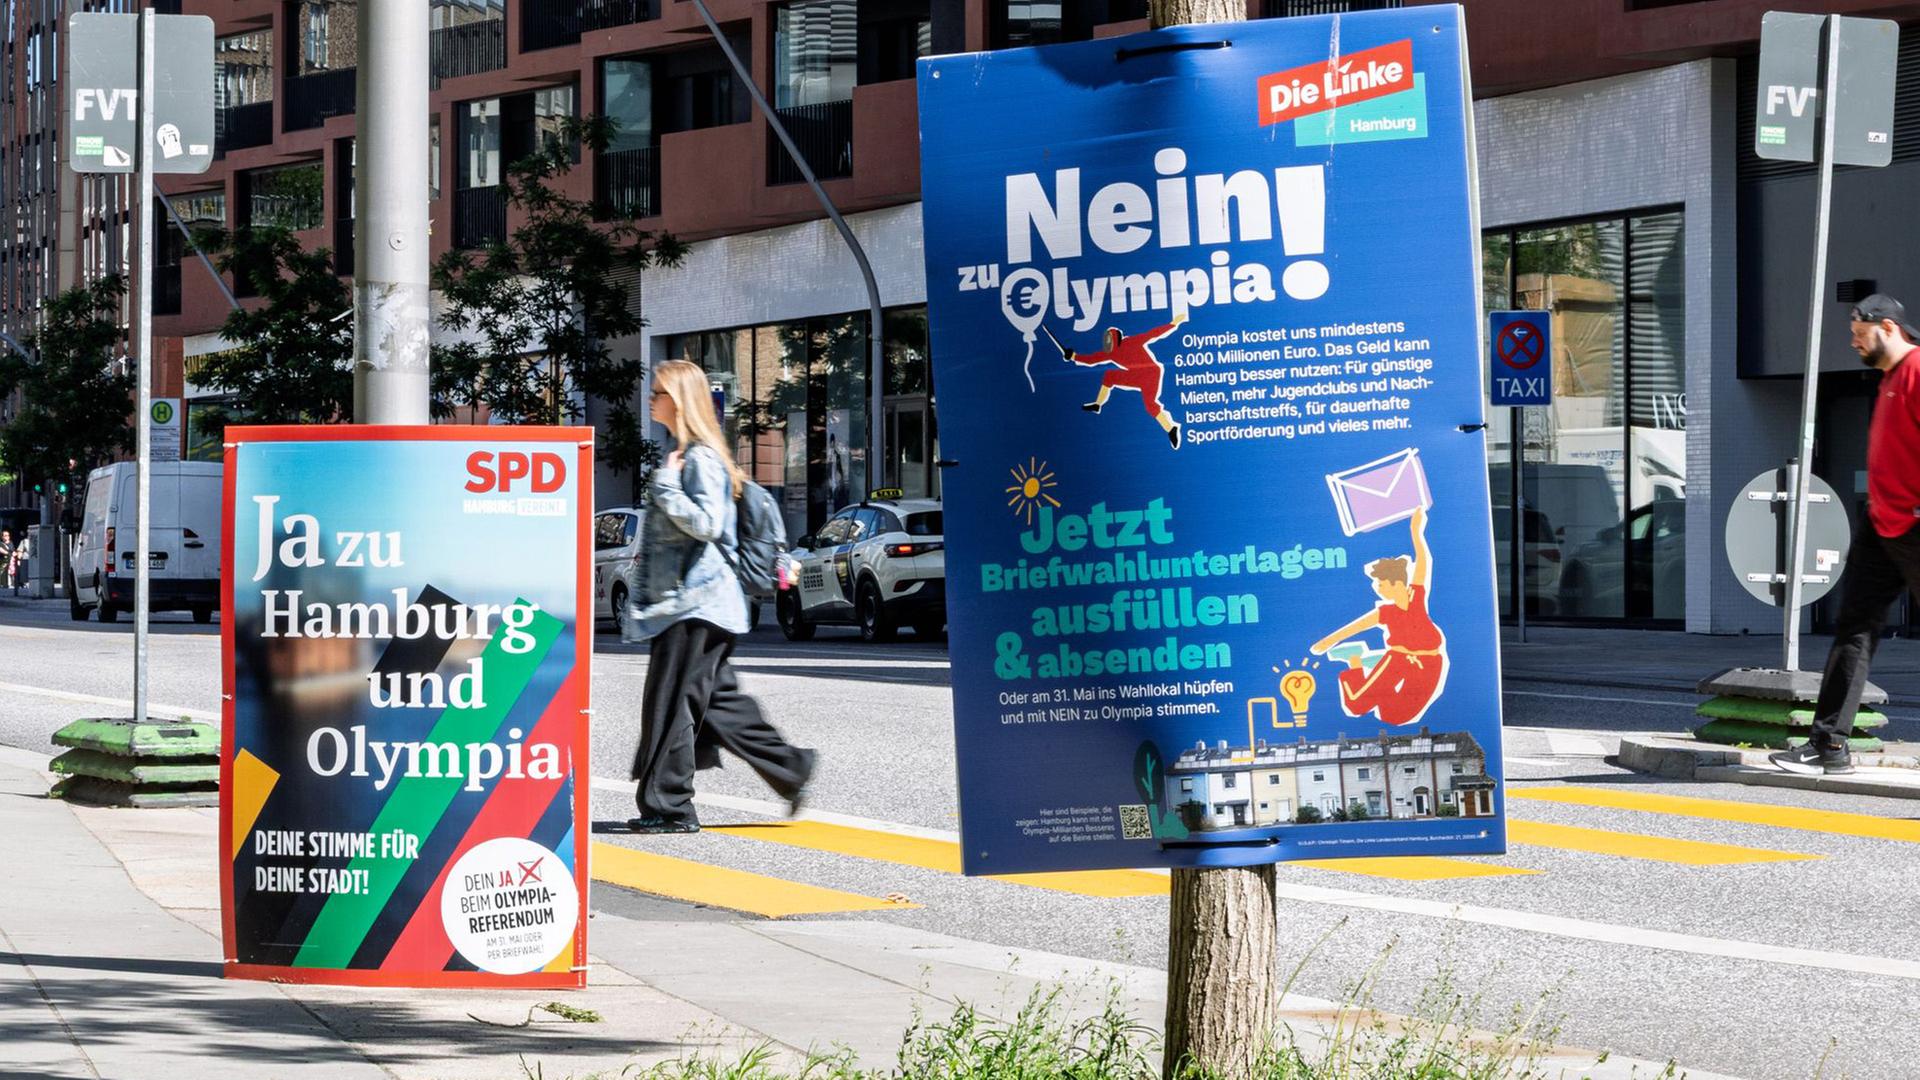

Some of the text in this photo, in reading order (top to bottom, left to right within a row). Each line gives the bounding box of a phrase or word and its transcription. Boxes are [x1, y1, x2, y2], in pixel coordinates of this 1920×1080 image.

[1270, 60, 1404, 113] Die Linke
[1350, 117, 1416, 132] Hamburg
[1006, 148, 1330, 300] Nein!
[958, 264, 1000, 291] zu
[1182, 322, 1405, 350] Olympia kostet uns mindestens
[1174, 338, 1430, 368] 6.000 Millionen Euro. Das Geld kann
[1175, 356, 1433, 386] Hamburg besser nutzen: Für günstige
[1180, 376, 1434, 406] Mieten, mehr Jugendclubs und Nach-
[1496, 378, 1545, 398] TAXI
[156, 406, 167, 418] H
[1186, 397, 1410, 424] barschaftstreffs, für dauerhafte
[1186, 416, 1412, 444] Sportförderung und vieles mehr.
[464, 450, 566, 494] SPD
[463, 500, 516, 514] HAMBURG
[252, 495, 404, 582] Ja zu
[1020, 497, 1174, 554] Jetzt
[981, 544, 1348, 592] Briefwahlunterlagen
[260, 588, 540, 654] Hamburg
[1032, 588, 1259, 637] ausfüllen
[994, 632, 1232, 680] & absenden
[366, 657, 488, 709] und
[999, 680, 1234, 706] Oder am 31. Mai ins Wahllokal hüpfen
[1001, 701, 1220, 724] und mit NEIN zu Olympia stimmen.
[306, 724, 563, 792] Olympia
[1040, 816, 1071, 826] Hamburg
[1072, 816, 1088, 824] kann
[1090, 814, 1100, 822] mit
[1100, 814, 1114, 822] den
[255, 828, 419, 859] DEINE STIMME FÜR
[255, 866, 369, 894] DEINE STADT!
[464, 870, 514, 892] DEIN JA
[460, 886, 556, 914] BEIM OLYMPIA-
[469, 907, 555, 934] REFERENDUM
[486, 936, 498, 948] AM
[509, 933, 522, 944] MAI
[524, 932, 543, 942] ODER
[488, 945, 544, 960] PER BRIEFWAHL!
